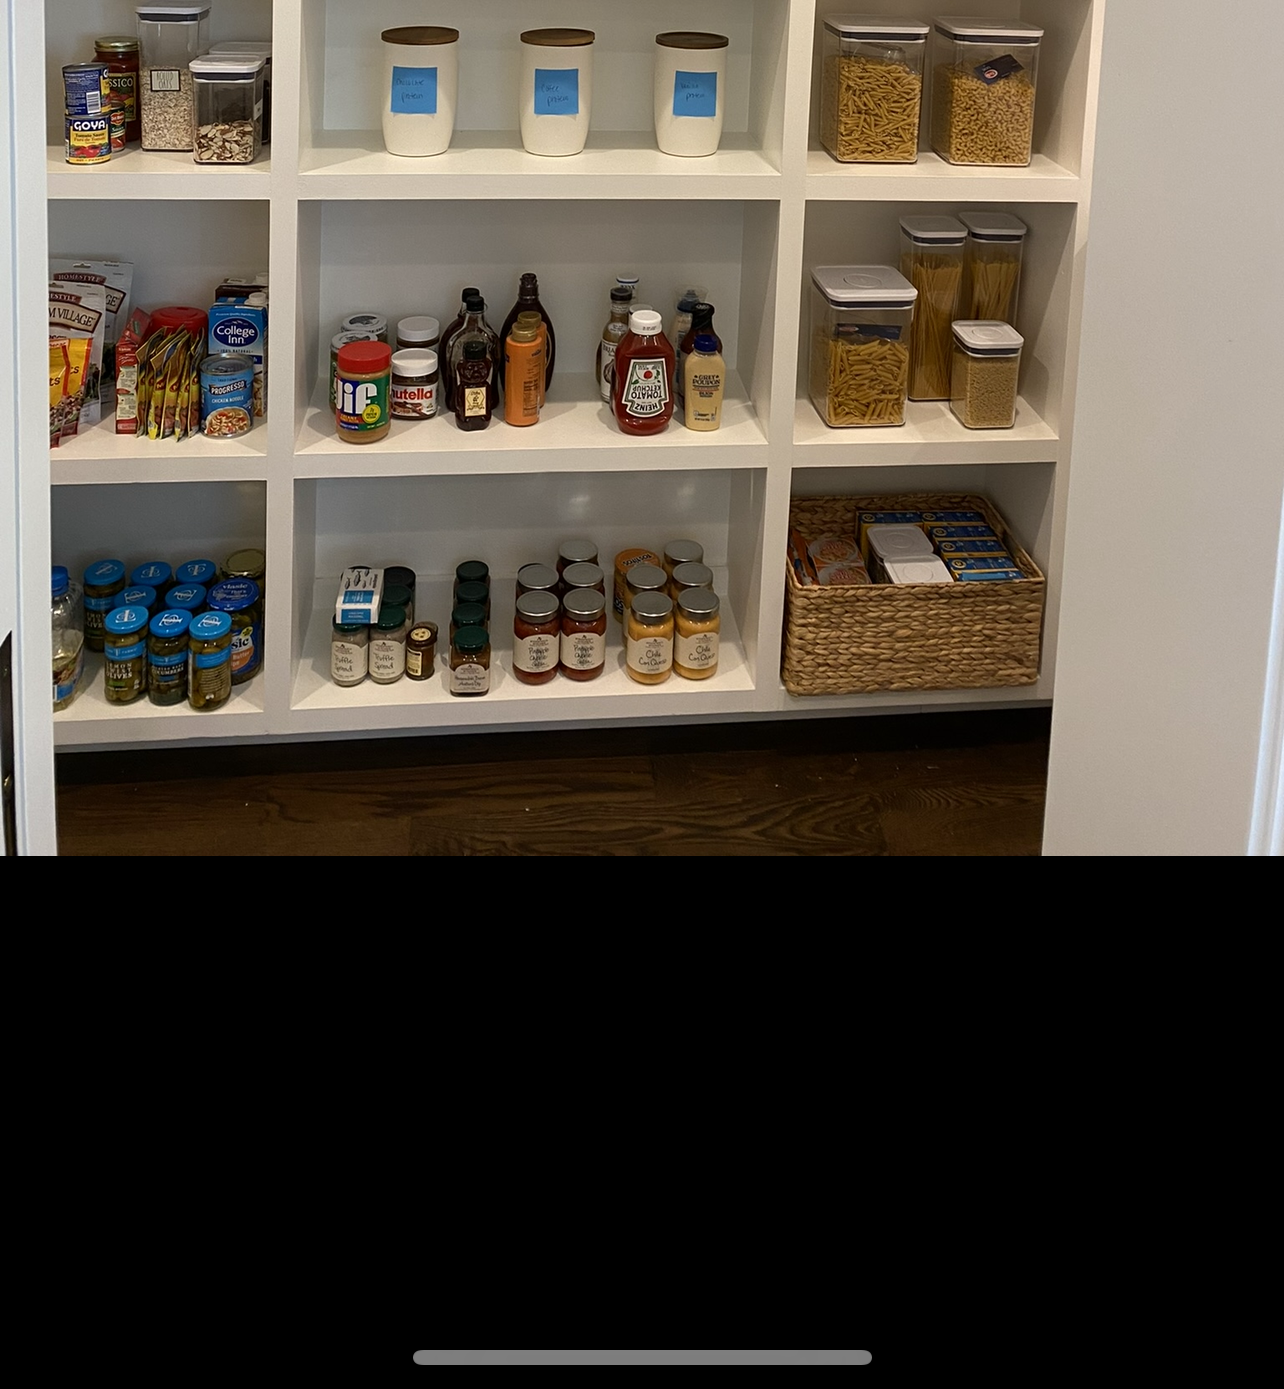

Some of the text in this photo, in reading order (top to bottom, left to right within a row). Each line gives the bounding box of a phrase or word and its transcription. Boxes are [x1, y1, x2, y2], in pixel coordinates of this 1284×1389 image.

[74, 119, 106, 131] GOYA
[58, 273, 100, 283] HOMESTYLE
[50, 293, 77, 302] ESTYLE
[58, 307, 94, 327] VILLAGE
[216, 325, 255, 338] College
[228, 335, 245, 344] Inn
[211, 380, 245, 395] PROGRESSO
[692, 378, 720, 386] POUPON
[336, 377, 377, 415] Jif
[392, 387, 433, 400] nutella
[631, 391, 662, 400] TOMATO
[634, 402, 658, 411] HEINZ
[622, 553, 652, 566] TOSTITOS
[231, 637, 250, 650] sic
[373, 652, 394, 661] Truffle
